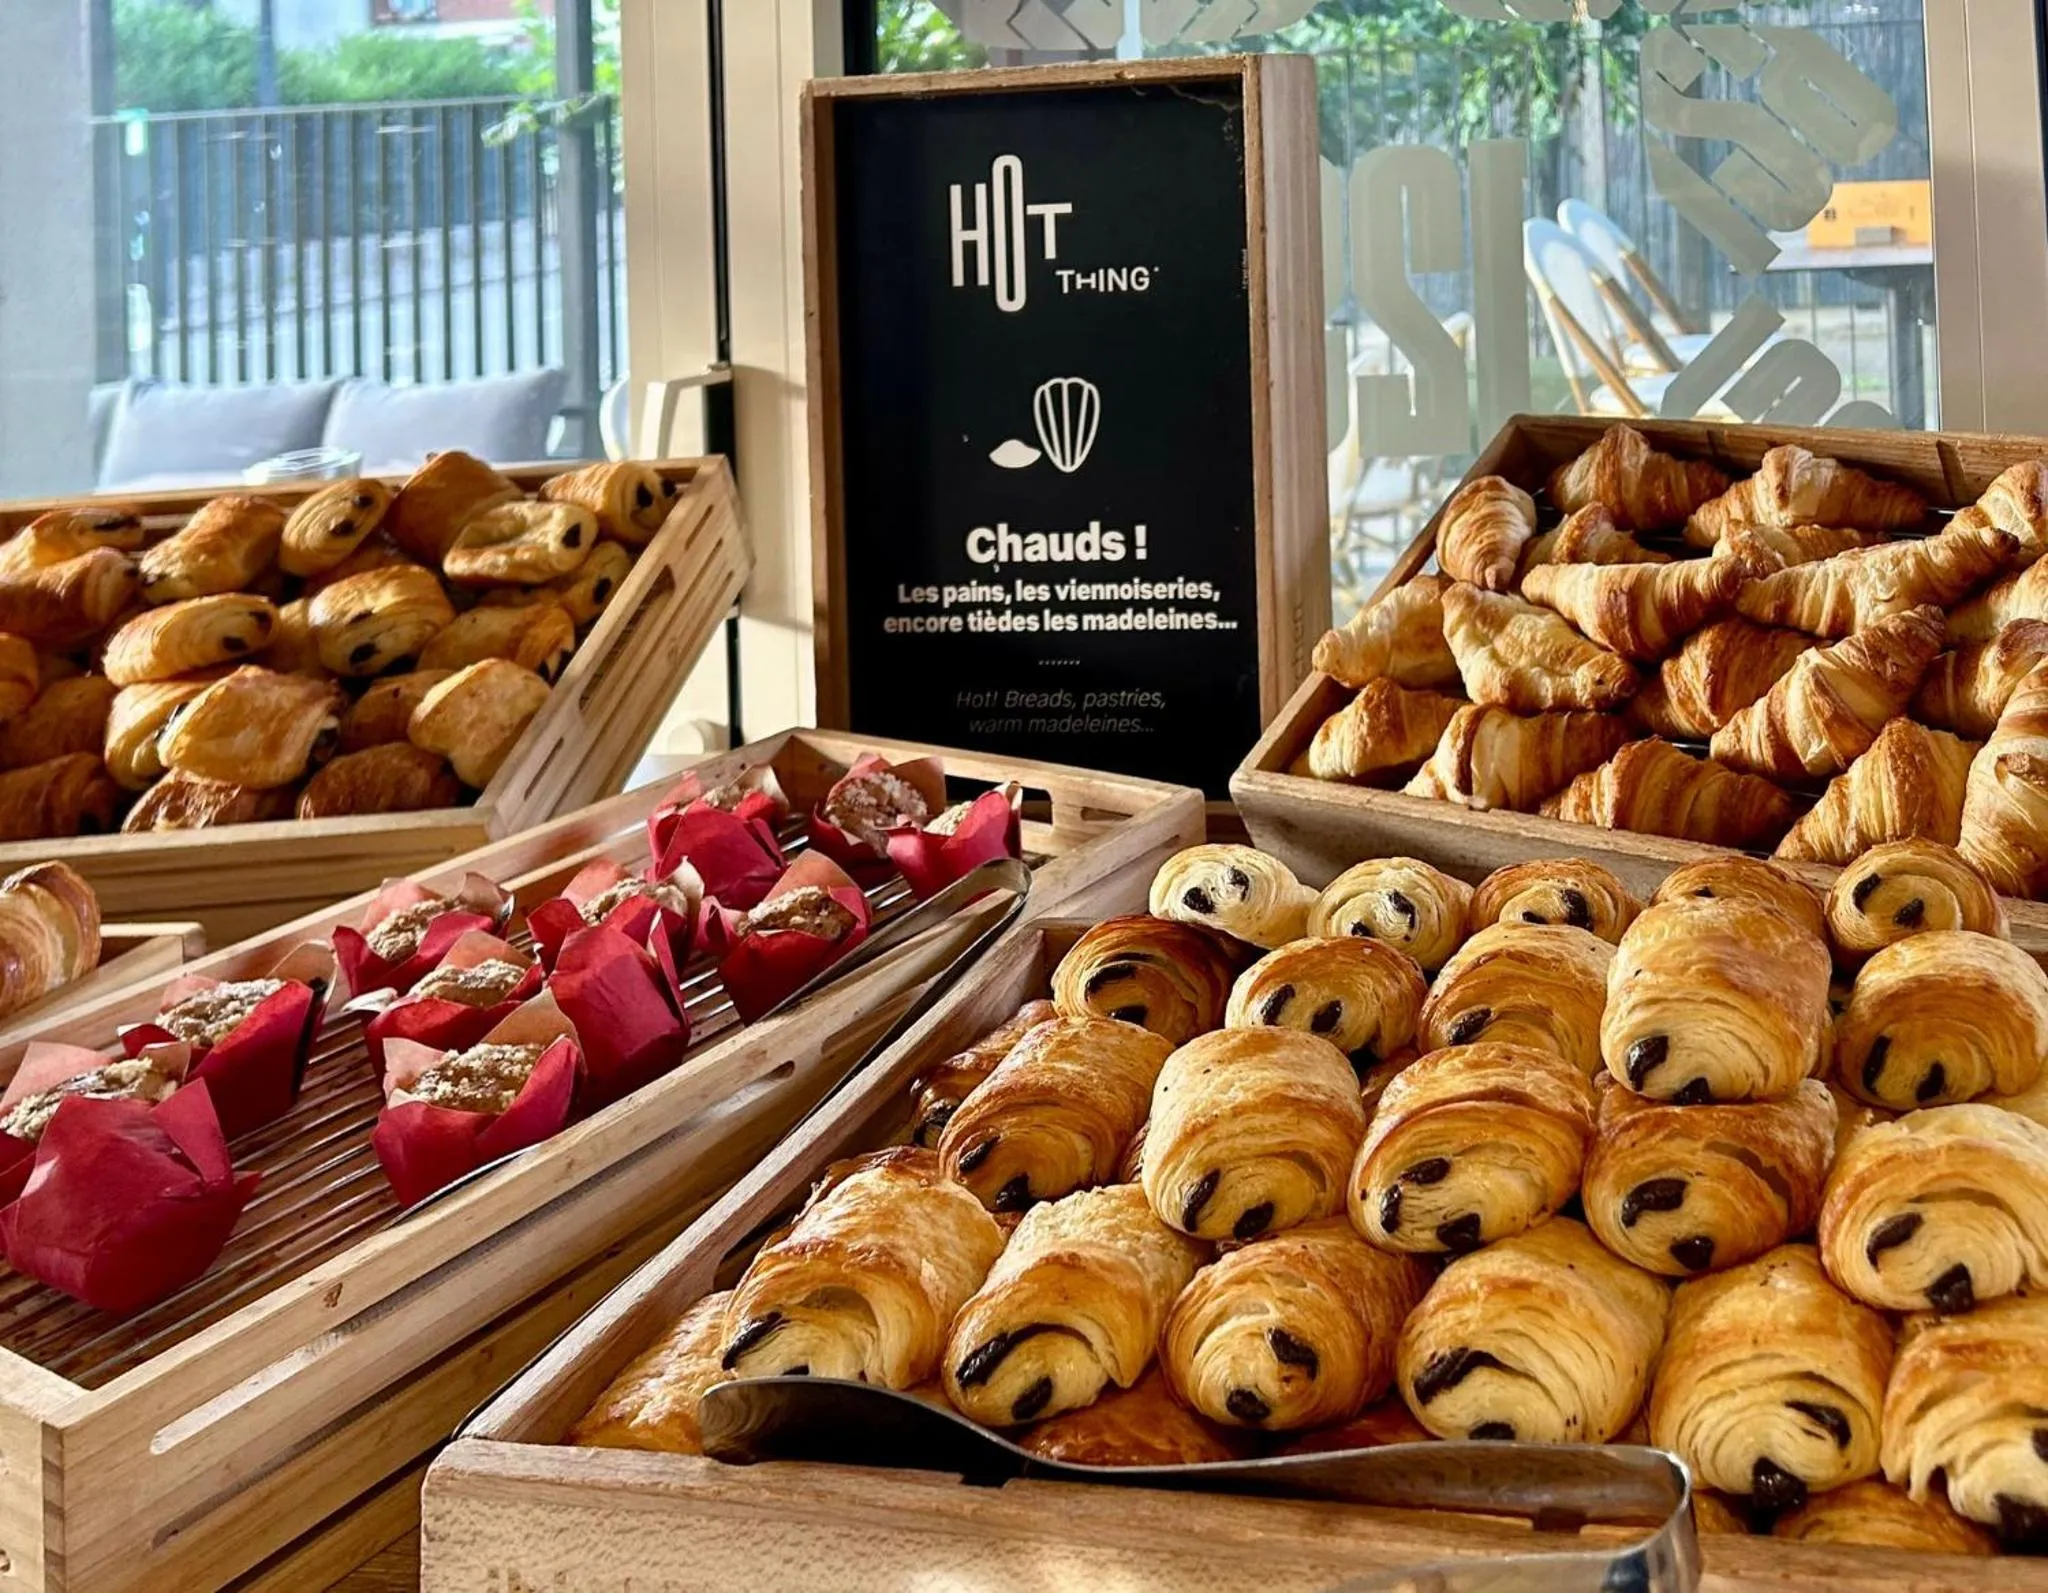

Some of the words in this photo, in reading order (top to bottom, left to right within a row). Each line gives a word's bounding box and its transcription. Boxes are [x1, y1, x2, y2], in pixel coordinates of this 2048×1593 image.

[949, 154, 1073, 312] HOT
[966, 520, 1127, 564] Chauds
[898, 583, 939, 604] Les
[943, 580, 1012, 609] pains,
[1015, 579, 1050, 602] les
[1055, 576, 1221, 602] viennoiseries,
[884, 613, 963, 633] encore
[967, 609, 1040, 632] tièdes
[1043, 608, 1079, 631] les
[1082, 607, 1238, 631] madeleines...
[956, 690, 999, 709] Hot!
[1004, 688, 1077, 711] Breads,
[1082, 688, 1166, 711] pastries,
[969, 717, 1022, 733] warm
